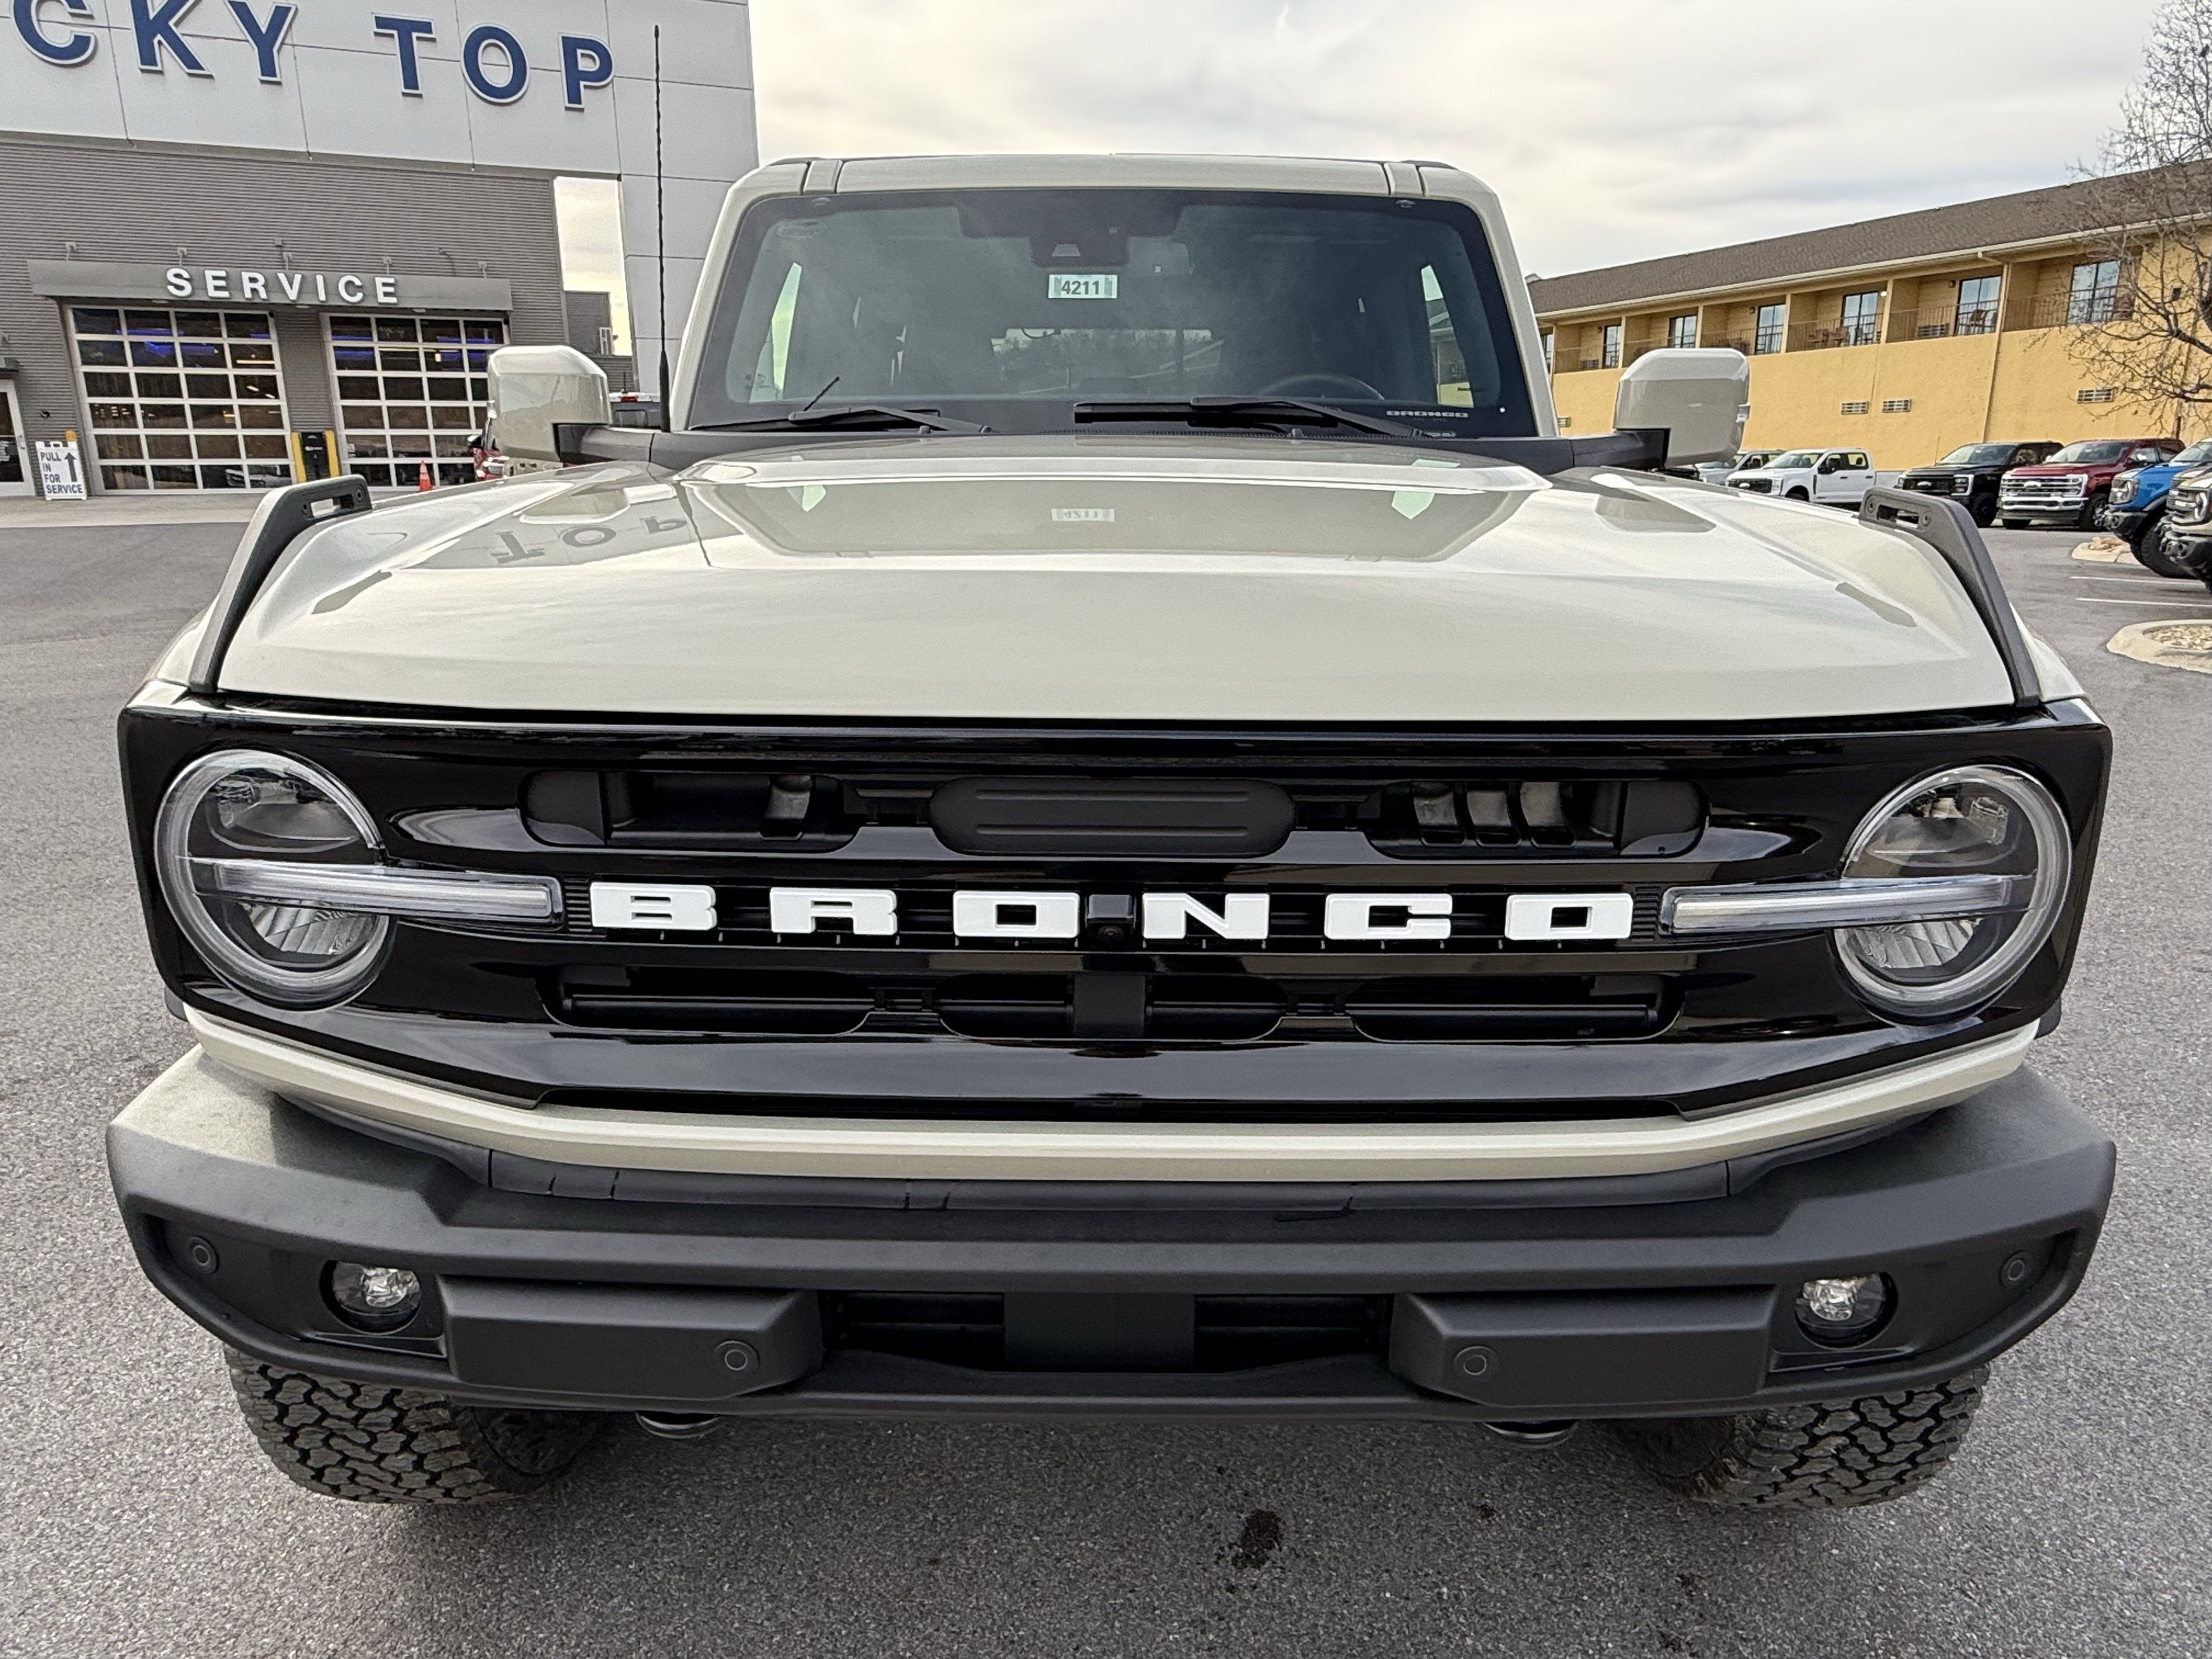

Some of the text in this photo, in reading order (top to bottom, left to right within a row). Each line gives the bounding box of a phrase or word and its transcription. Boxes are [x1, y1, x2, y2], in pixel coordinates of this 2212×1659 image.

[11, 0, 613, 111] CKY TOP
[166, 267, 398, 304] SERVICE
[1061, 280, 1099, 295] 4211
[40, 451, 61, 461] PULL
[43, 463, 52, 472] IN
[44, 473, 61, 483] FOR
[46, 484, 83, 494] SERVICE
[590, 881, 1633, 940] BRONCO
